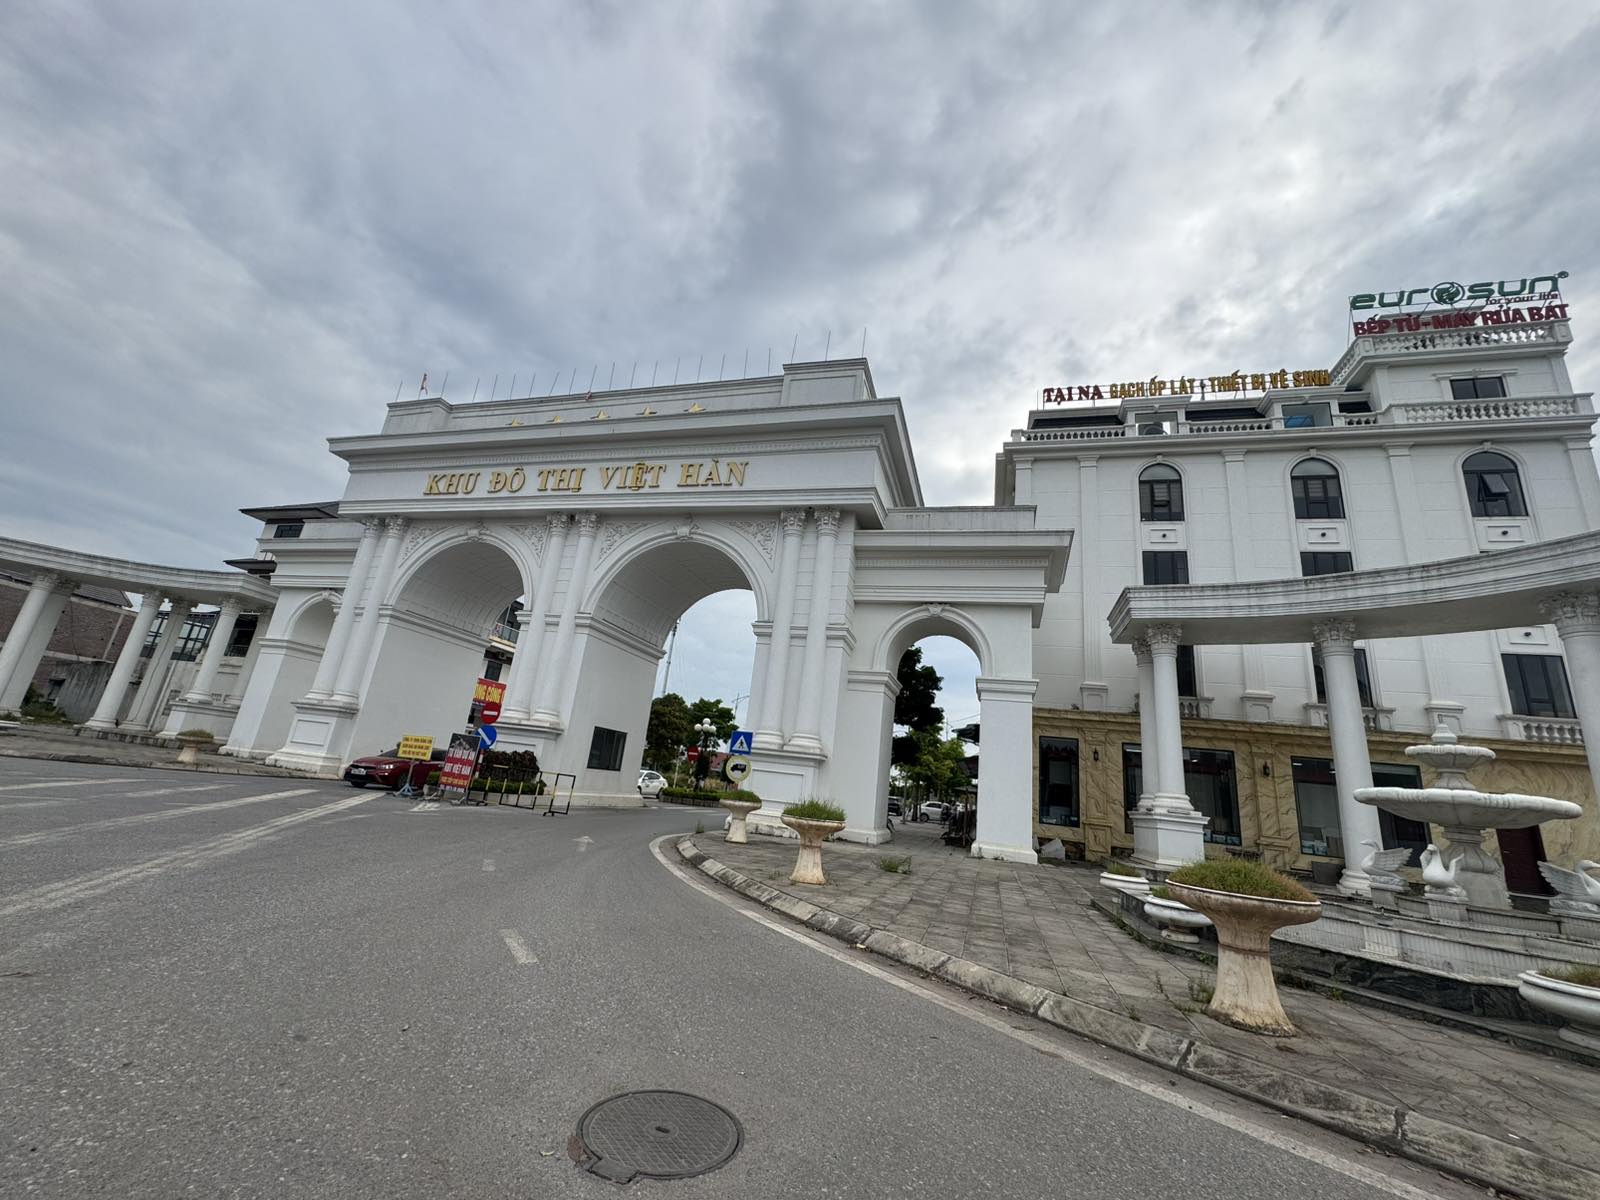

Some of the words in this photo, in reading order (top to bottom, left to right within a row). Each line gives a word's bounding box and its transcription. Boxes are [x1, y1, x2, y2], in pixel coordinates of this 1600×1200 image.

[1505, 294, 1536, 304] your
[1353, 313, 1391, 337] BẾP
[1480, 302, 1527, 326] RỬA
[1527, 300, 1569, 322] BÁT
[1077, 384, 1104, 401] NA
[1148, 375, 1167, 397] ỐP
[1170, 375, 1195, 396] LÁT
[1207, 369, 1248, 394] THIẾT
[1250, 373, 1267, 393] BỊ
[1292, 369, 1331, 388] SINH
[423, 471, 481, 495] KHU
[487, 464, 527, 494] ĐÔ
[536, 467, 587, 493] THỊ
[600, 458, 668, 491] VIỆT
[676, 456, 750, 488] HÀN
